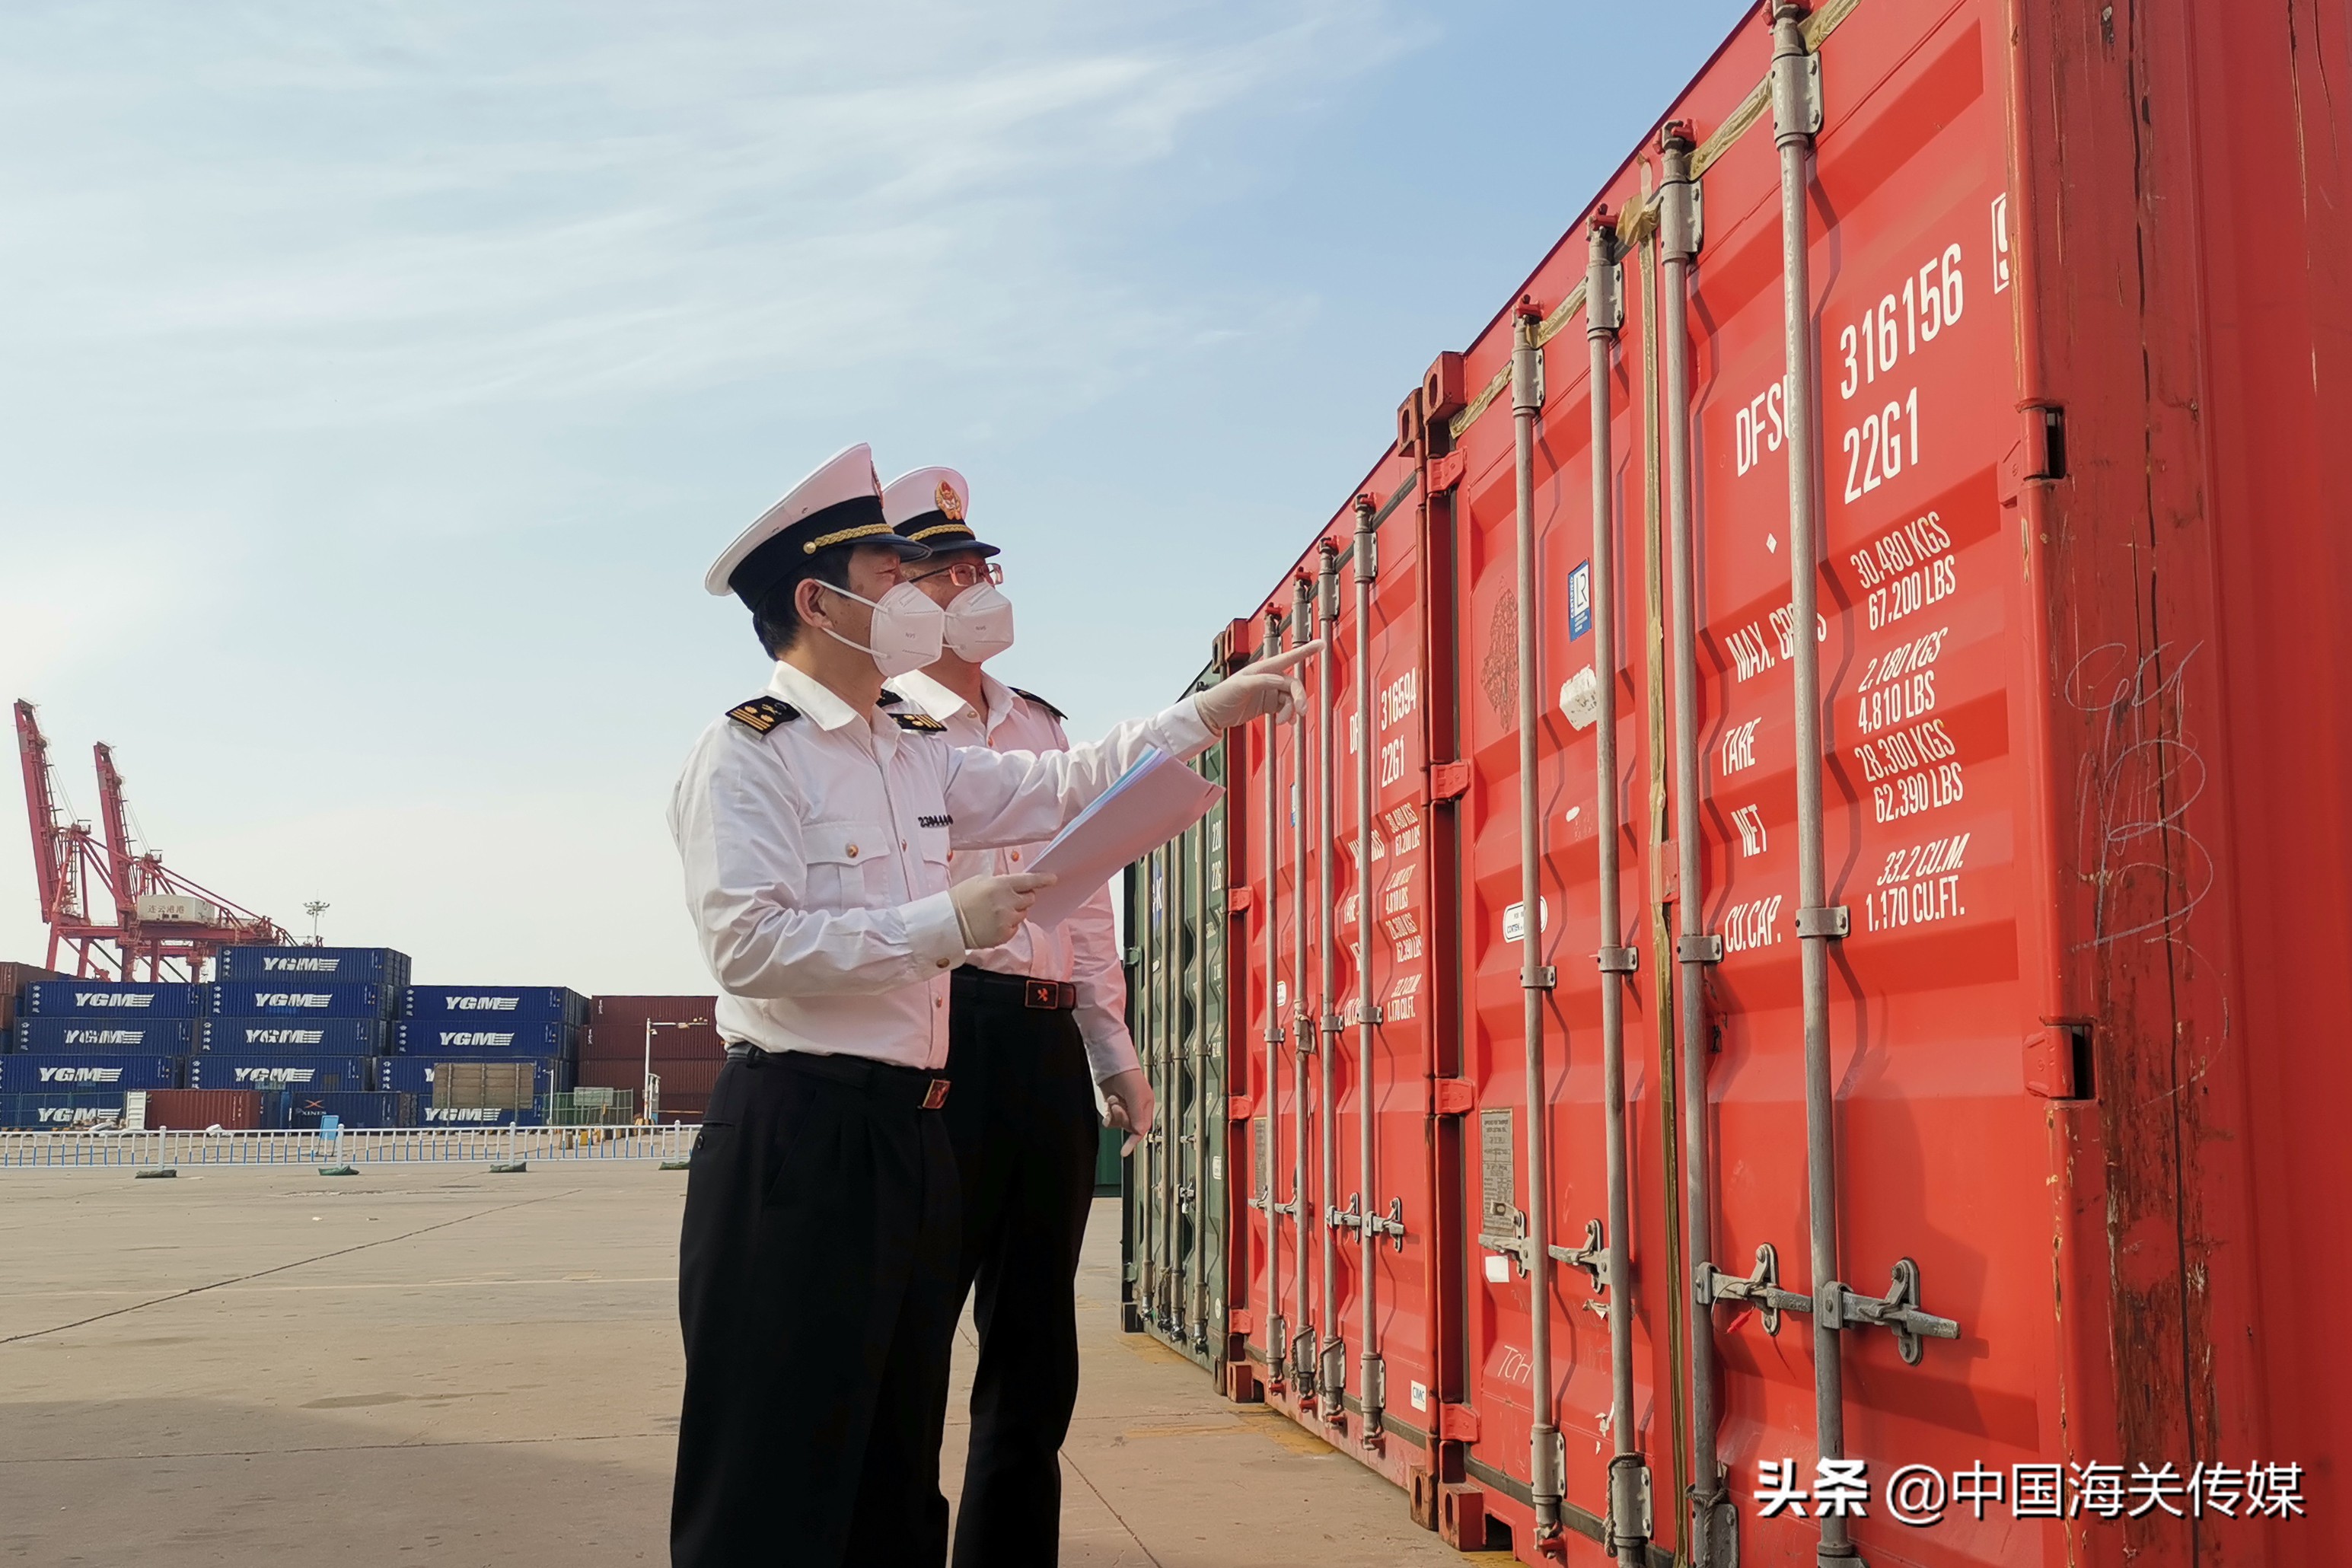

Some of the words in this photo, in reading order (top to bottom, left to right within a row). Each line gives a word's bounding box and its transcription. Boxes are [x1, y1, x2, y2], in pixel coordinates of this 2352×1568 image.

[1840, 242, 1964, 400] 316156
[1843, 386, 1919, 505] 22G1
[1850, 531, 1914, 589] 30,480
[1904, 511, 1951, 561] KGS
[1868, 571, 1922, 631] 67,200
[1923, 554, 1956, 605] LBS
[1724, 620, 1775, 684] MAX.
[1768, 602, 1827, 661] GRS
[1904, 626, 1949, 674] KGS
[1381, 667, 1417, 731] 316594
[1858, 683, 1901, 735] 4,810
[1904, 669, 1936, 719] LBS
[1382, 734, 1404, 789] 22G1
[1722, 716, 1762, 776] TARE
[1908, 718, 1956, 764] KGS
[1873, 772, 1929, 824] 62,390
[1929, 761, 1964, 808] LBS
[1730, 803, 1767, 859] NET
[1876, 845, 1922, 887] 33.2
